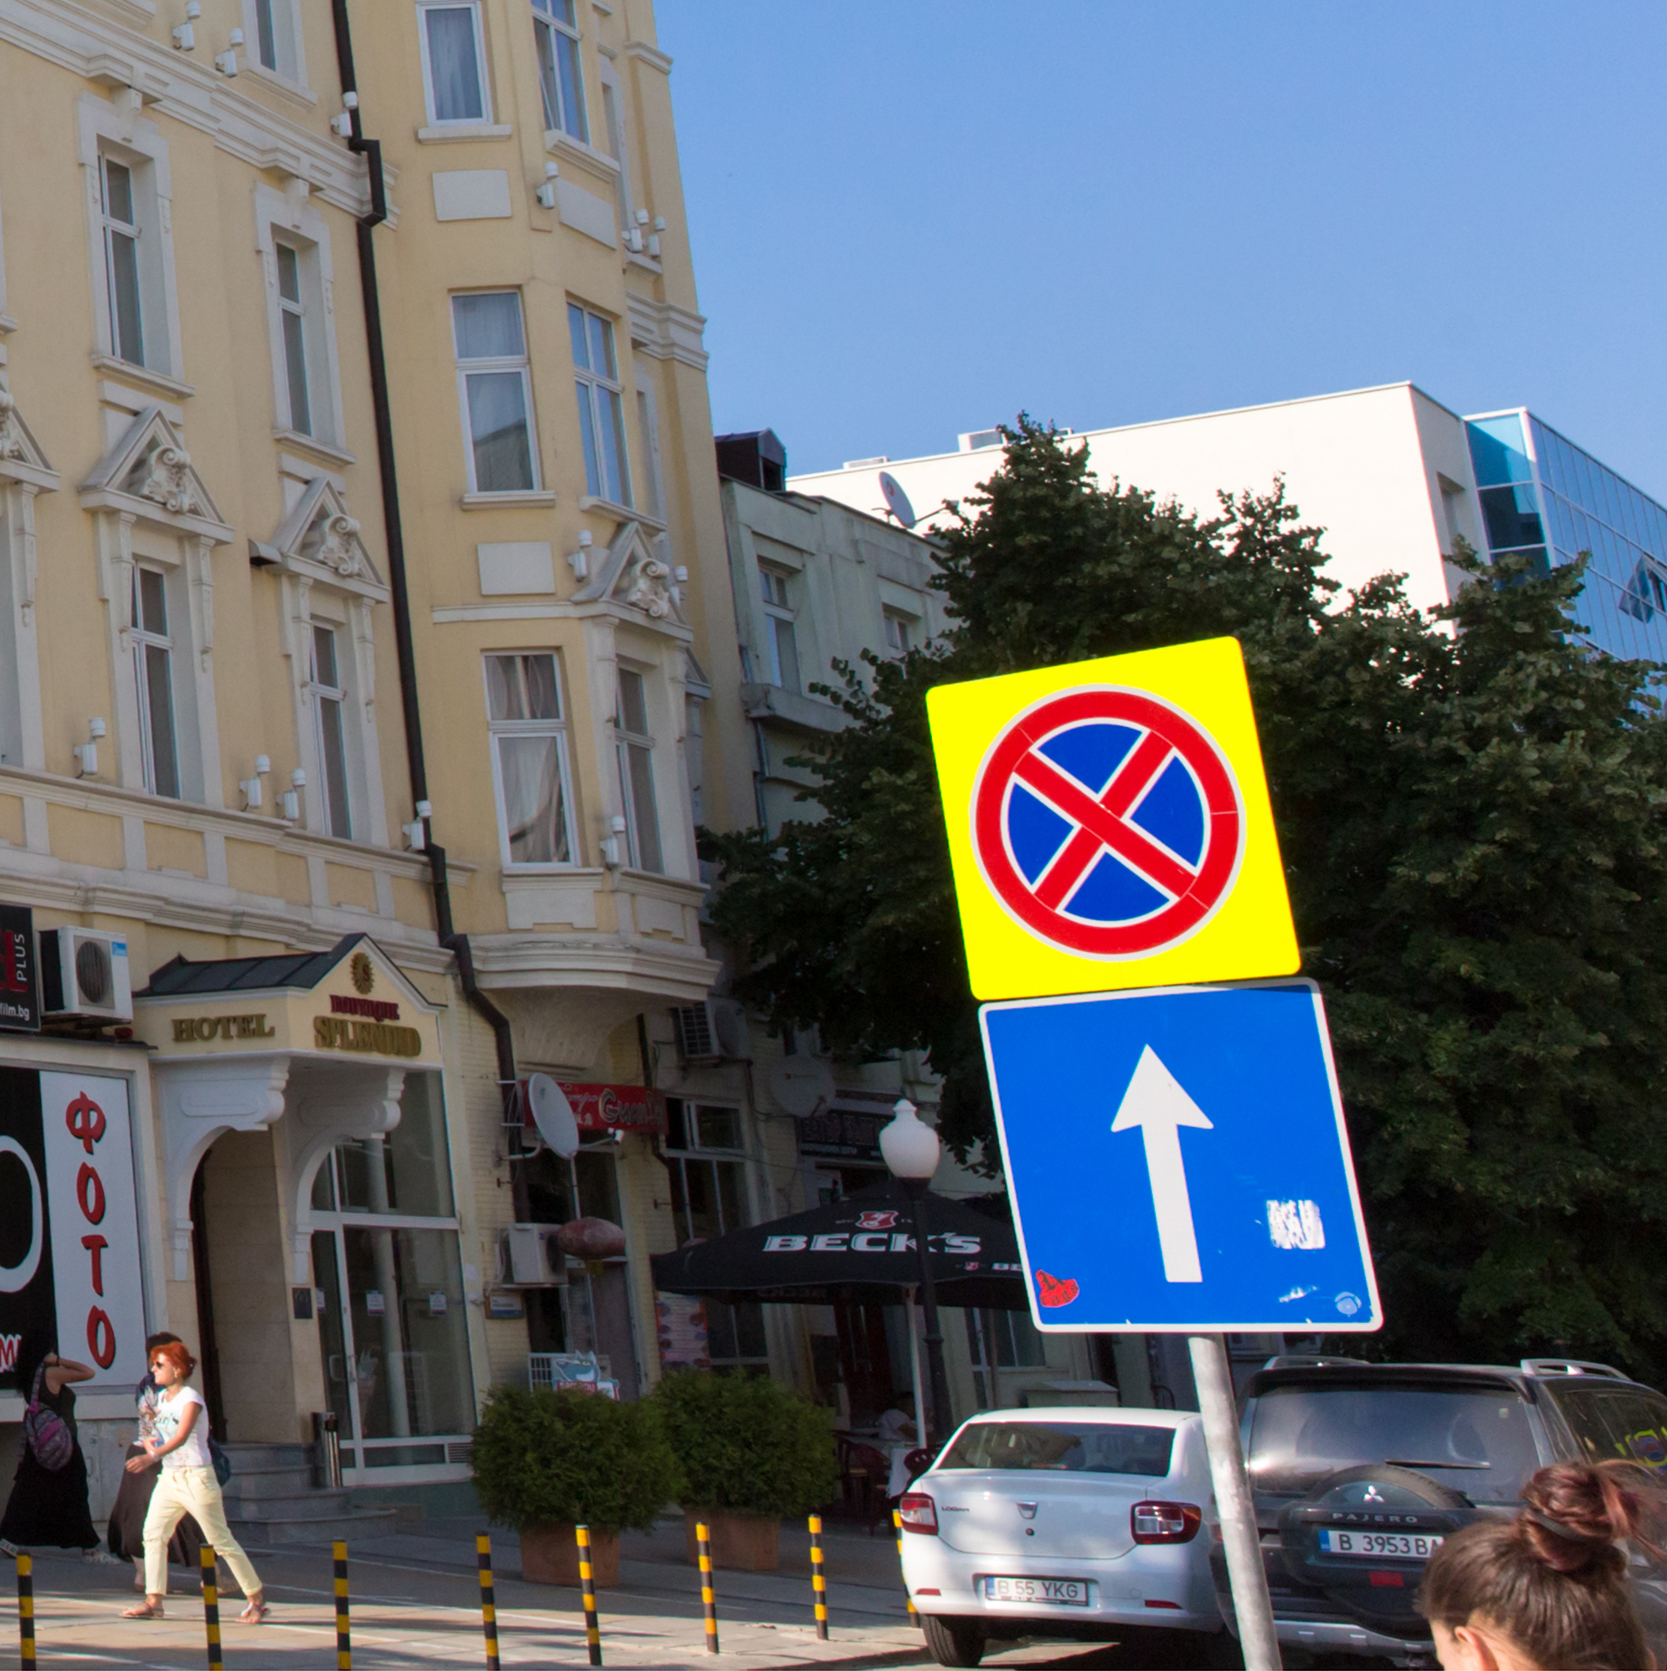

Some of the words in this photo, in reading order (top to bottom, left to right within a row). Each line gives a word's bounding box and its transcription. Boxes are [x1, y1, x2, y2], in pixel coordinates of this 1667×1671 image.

[13, 932, 28, 983] PLUS
[170, 1012, 276, 1044] HOTEL
[312, 1015, 423, 1058] SPLENDID
[64, 1090, 117, 1371] ФОТО
[761, 1231, 983, 1255] BECK'S
[991, 1262, 1024, 1273] BE
[1331, 1511, 1419, 1524] PAJERO
[1338, 1533, 1354, 1552] B
[1361, 1534, 1412, 1555] 3953
[996, 1578, 1010, 1595] B
[1014, 1580, 1036, 1597] 55
[1040, 1581, 1079, 1599] YKG
